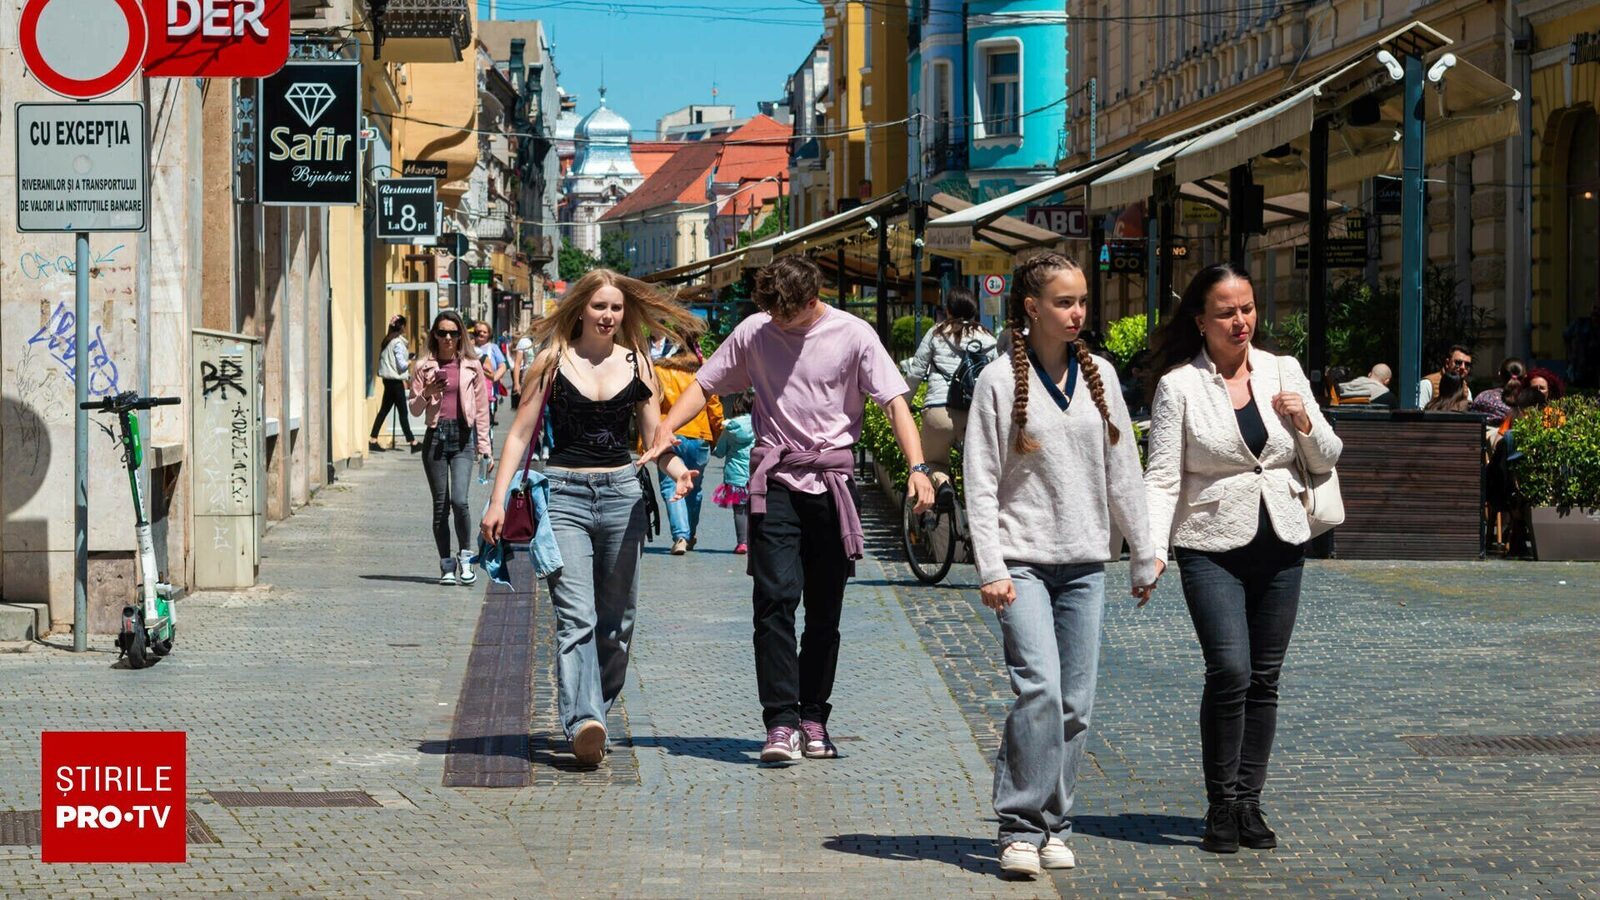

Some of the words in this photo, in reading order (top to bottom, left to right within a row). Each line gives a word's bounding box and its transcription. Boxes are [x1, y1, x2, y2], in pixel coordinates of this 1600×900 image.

[167, 0, 270, 37] DER
[30, 121, 51, 146] CU
[56, 120, 130, 148] EXCEPȚIA
[269, 126, 352, 161] Safir
[22, 178, 66, 191] RIVERANILOR
[67, 178, 74, 193] ȘI
[75, 178, 81, 191] A
[82, 178, 137, 191] TRANSPORTULUI
[291, 165, 352, 188] Bijuterii
[379, 184, 433, 195] Restaurant
[20, 200, 29, 212] DE
[30, 200, 54, 212] VALORI
[55, 200, 65, 212] LA
[110, 200, 142, 212] BANCARE
[388, 221, 400, 230] La
[400, 204, 417, 232] 8
[417, 221, 428, 232] pt
[1033, 210, 1083, 234] ABC
